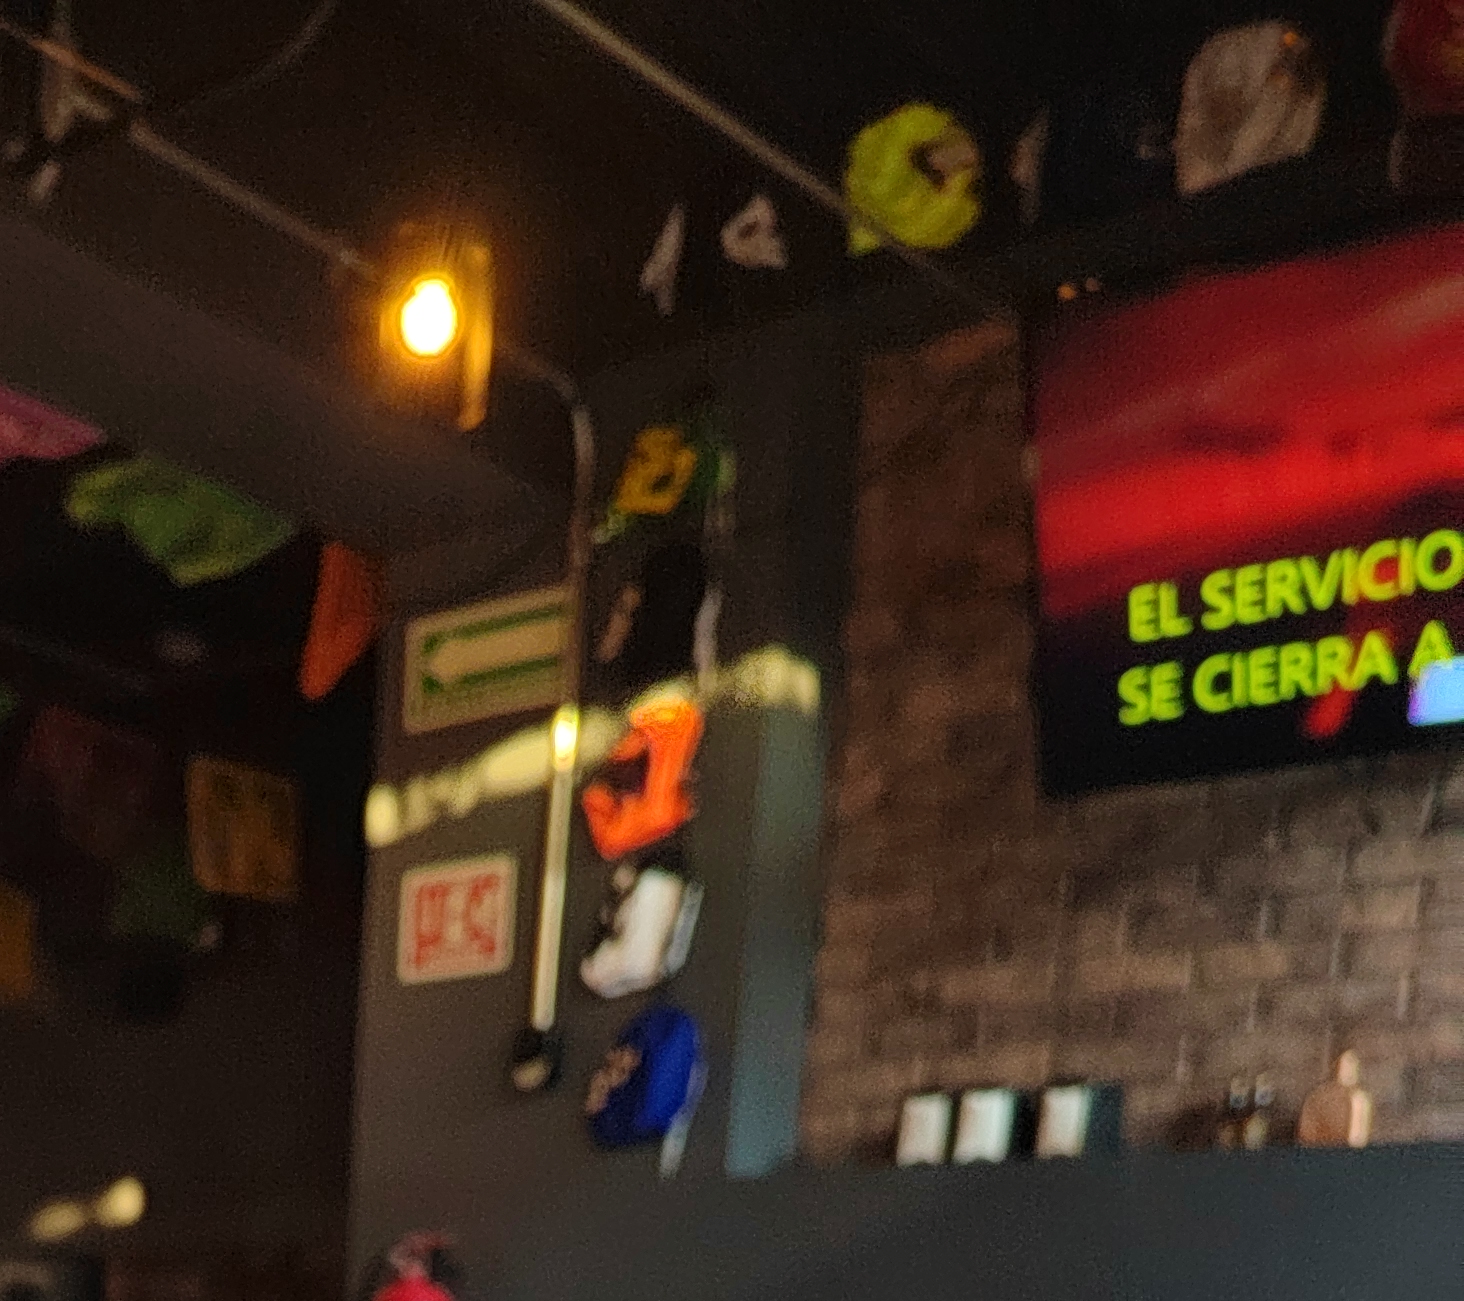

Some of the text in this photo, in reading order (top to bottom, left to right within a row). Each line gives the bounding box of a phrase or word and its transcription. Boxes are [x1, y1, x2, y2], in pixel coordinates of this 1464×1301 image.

[1128, 528, 1464, 643] EL SERVICIO
[1117, 660, 1186, 726] SE
[1191, 629, 1399, 714] CIERRA
